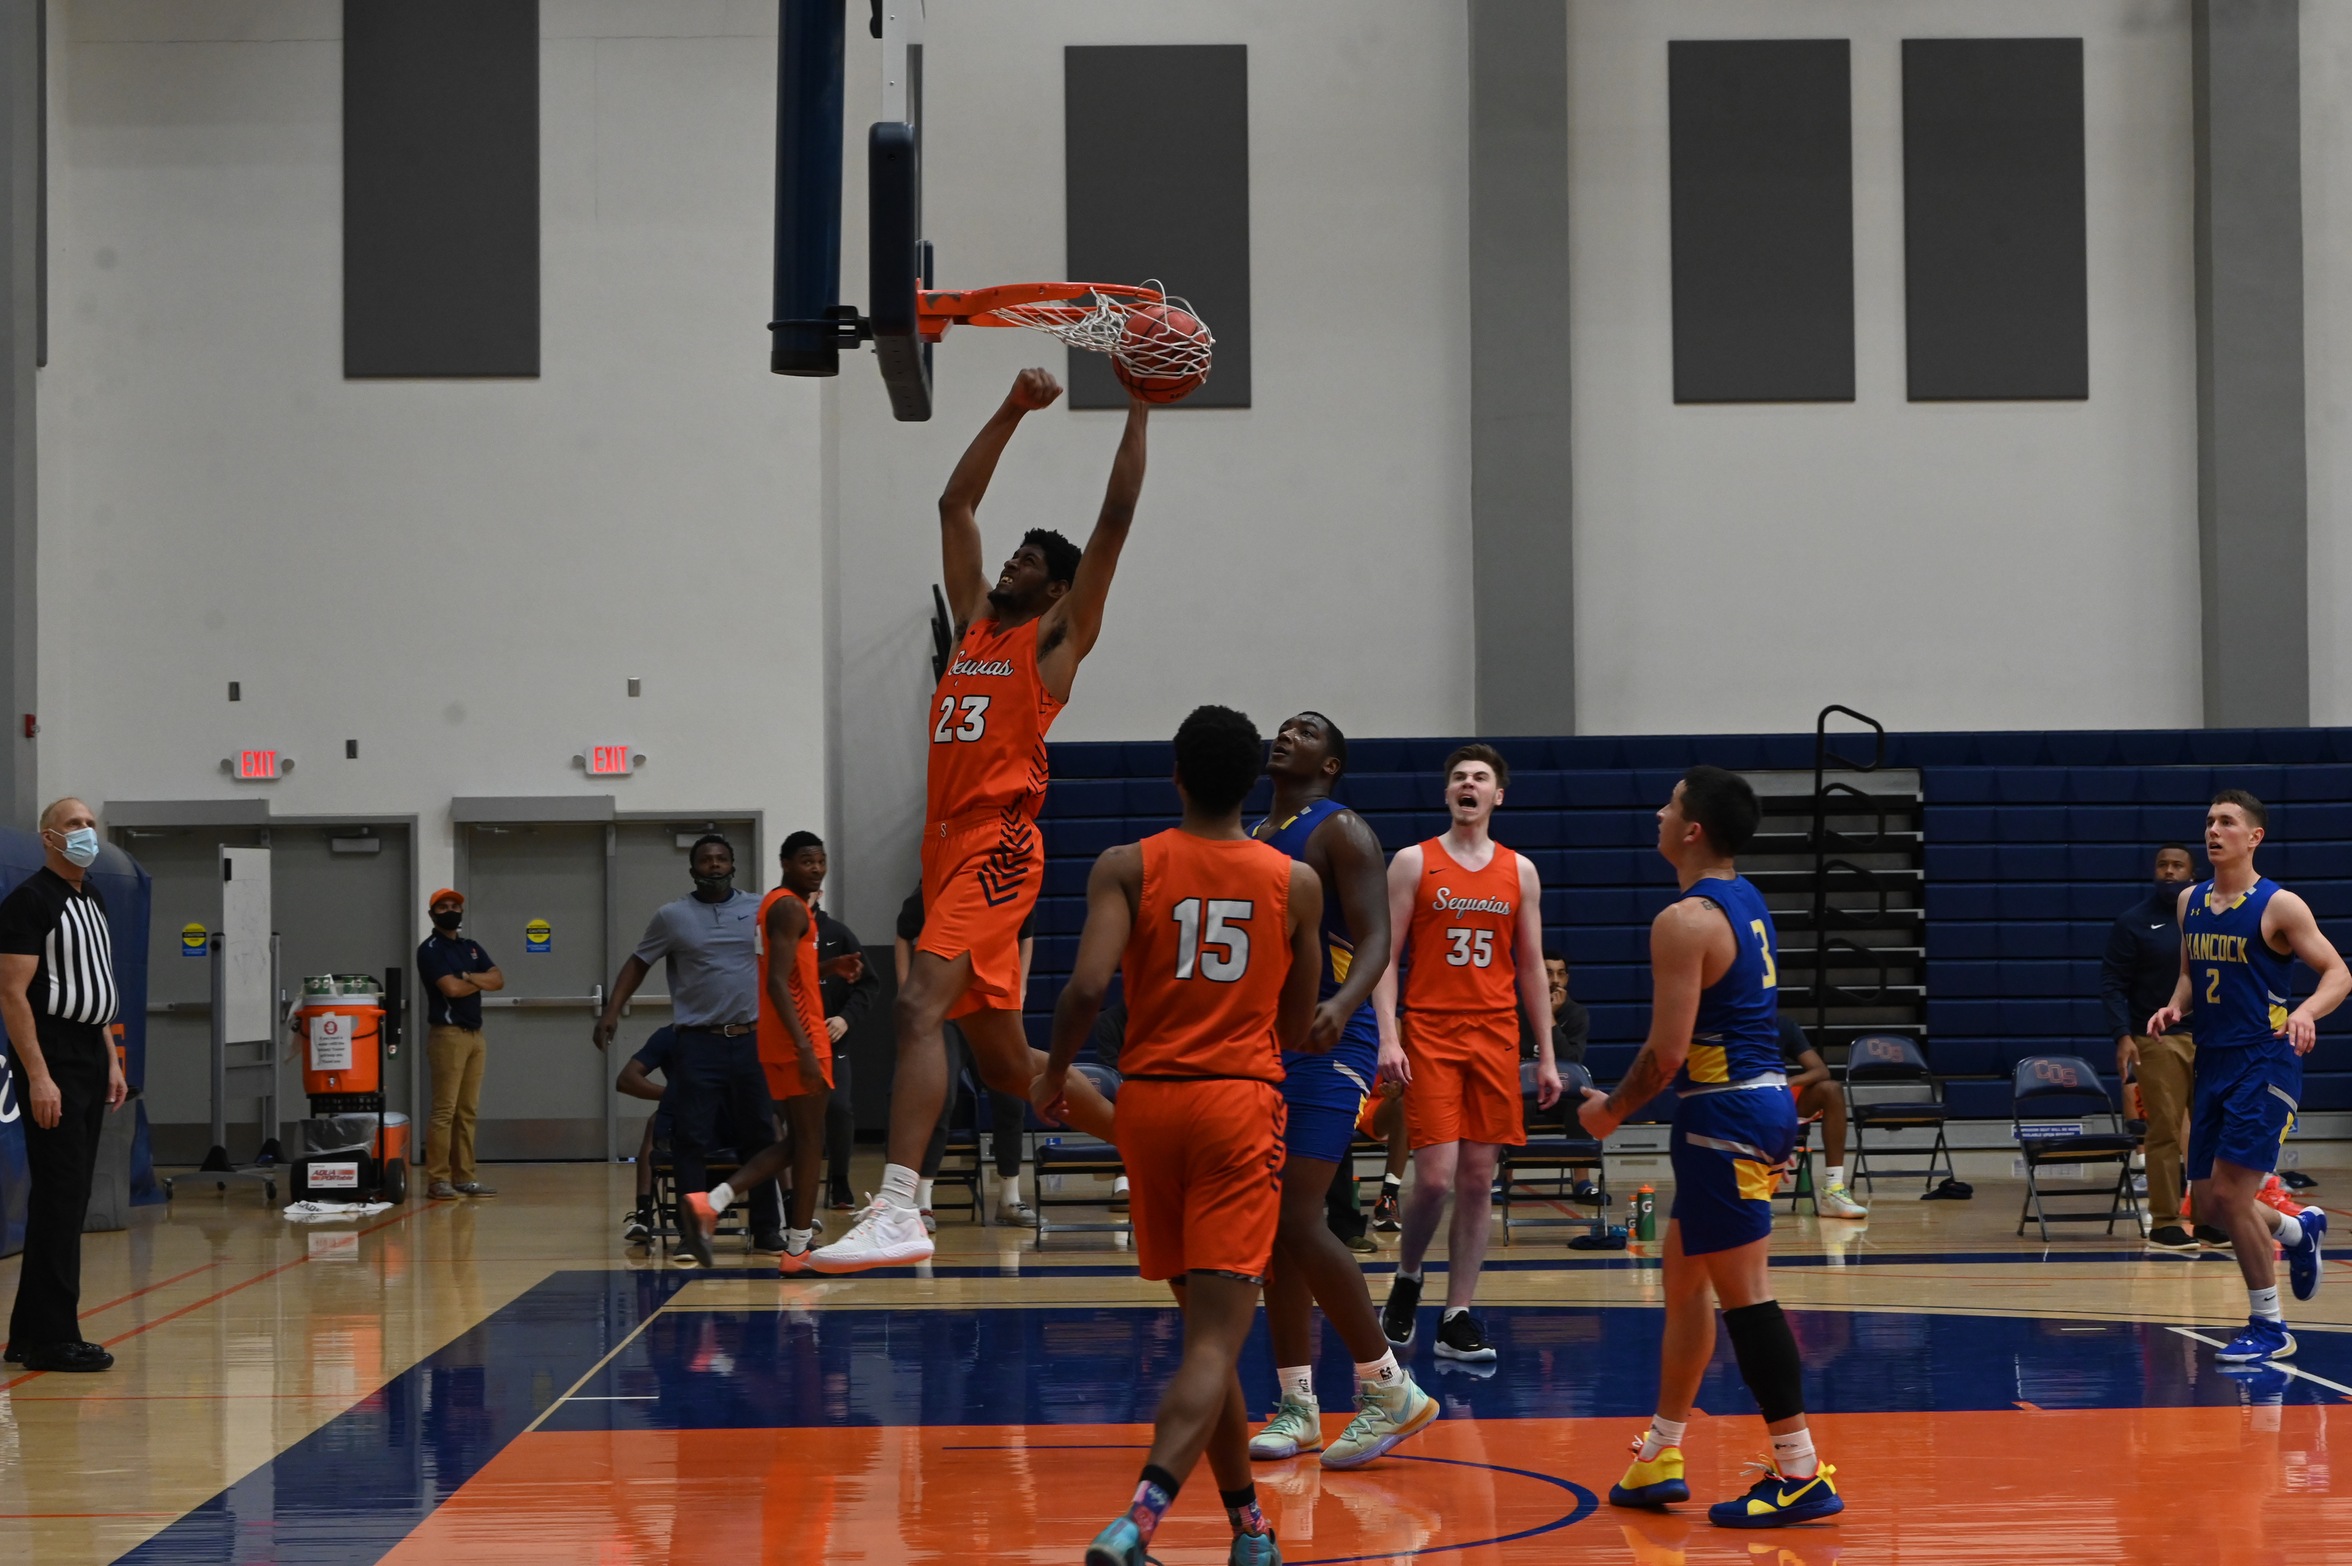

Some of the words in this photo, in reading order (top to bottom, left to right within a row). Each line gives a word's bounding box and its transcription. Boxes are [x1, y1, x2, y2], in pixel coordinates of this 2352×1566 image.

[933, 694, 991, 743] 23
[241, 750, 276, 777] EXIT
[593, 745, 628, 773] EXIT
[1433, 886, 1511, 919] Sequoias
[1172, 897, 1254, 983] 15
[1446, 927, 1495, 968] 35
[1750, 918, 1777, 989] 3
[2206, 968, 2221, 1004] 2
[2034, 1059, 2078, 1088] COS
[1641, 1200, 1653, 1213] G
[1628, 1218, 1637, 1229] G
